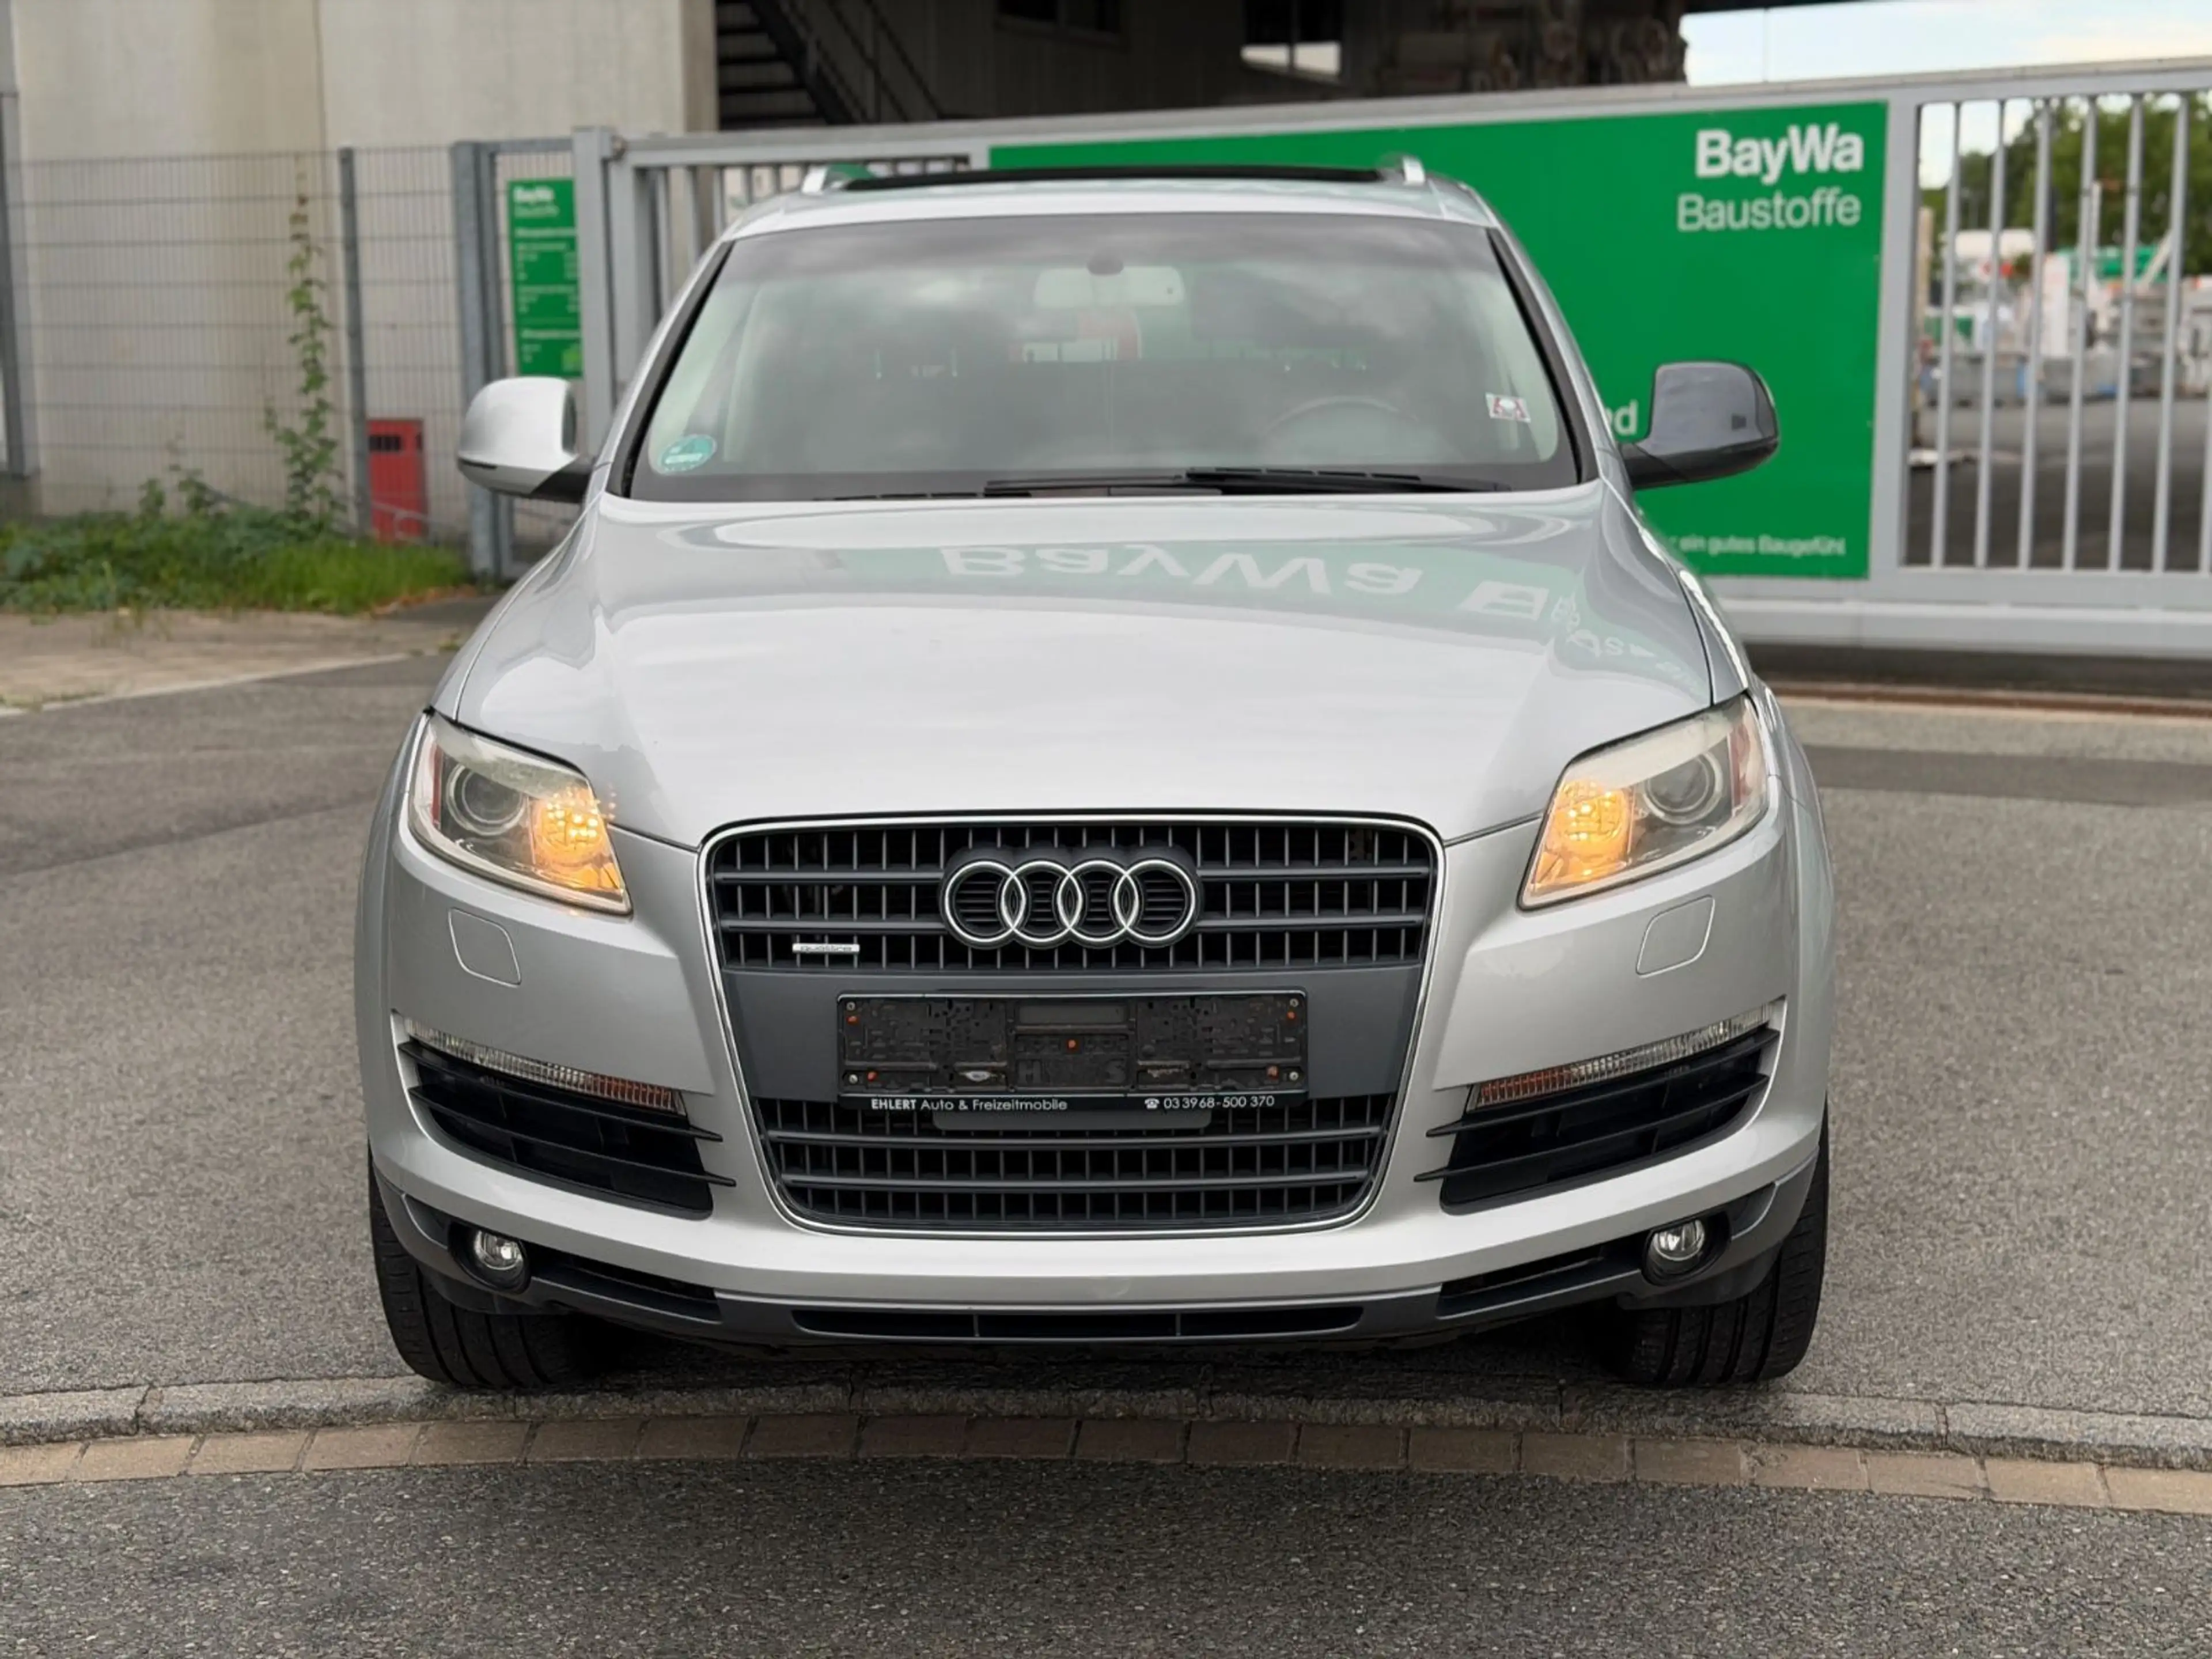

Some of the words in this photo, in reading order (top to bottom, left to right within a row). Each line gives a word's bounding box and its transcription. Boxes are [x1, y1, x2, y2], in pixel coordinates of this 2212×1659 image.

[1696, 122, 1864, 185] BayWa
[1677, 187, 1861, 232] Baustoffe
[871, 1098, 916, 1111] EHLERT
[920, 1099, 954, 1111] Auto
[957, 1099, 968, 1111] &
[972, 1099, 1068, 1111] Freizeitmobile
[1249, 1095, 1275, 1108] 370
